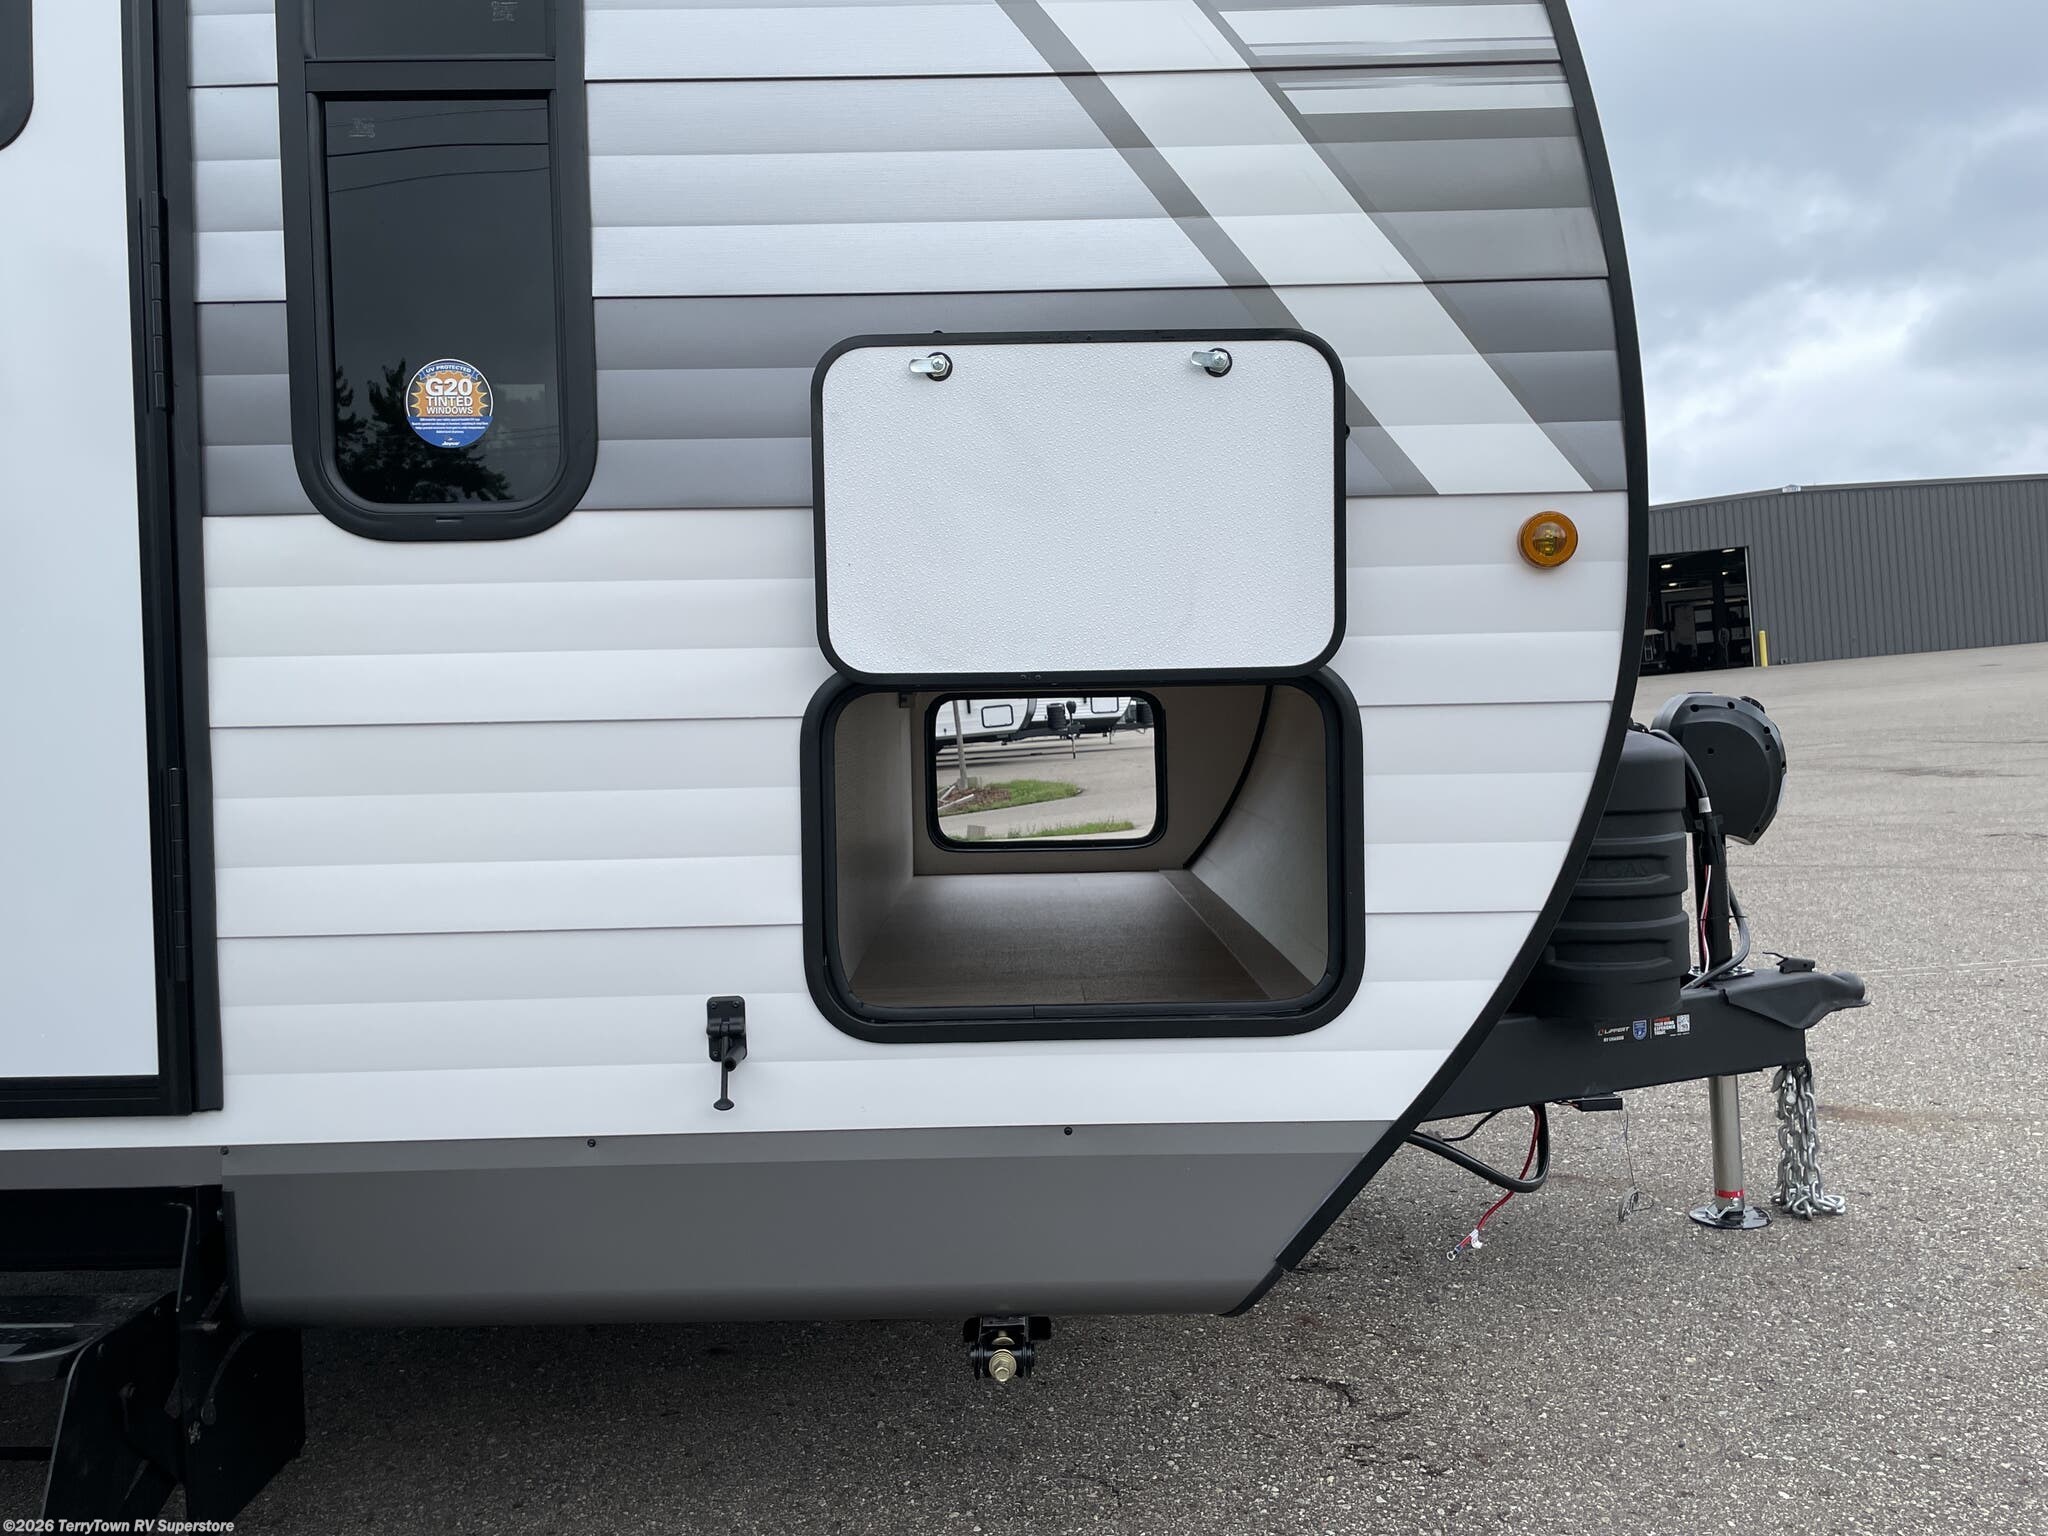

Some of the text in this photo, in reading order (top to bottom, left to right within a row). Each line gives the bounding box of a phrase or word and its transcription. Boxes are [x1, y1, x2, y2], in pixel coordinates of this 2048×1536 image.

[436, 364, 472, 373] PROTECTED
[425, 378, 473, 396] G20
[426, 396, 473, 407] TINTED
[427, 407, 473, 415] WINDOWS
